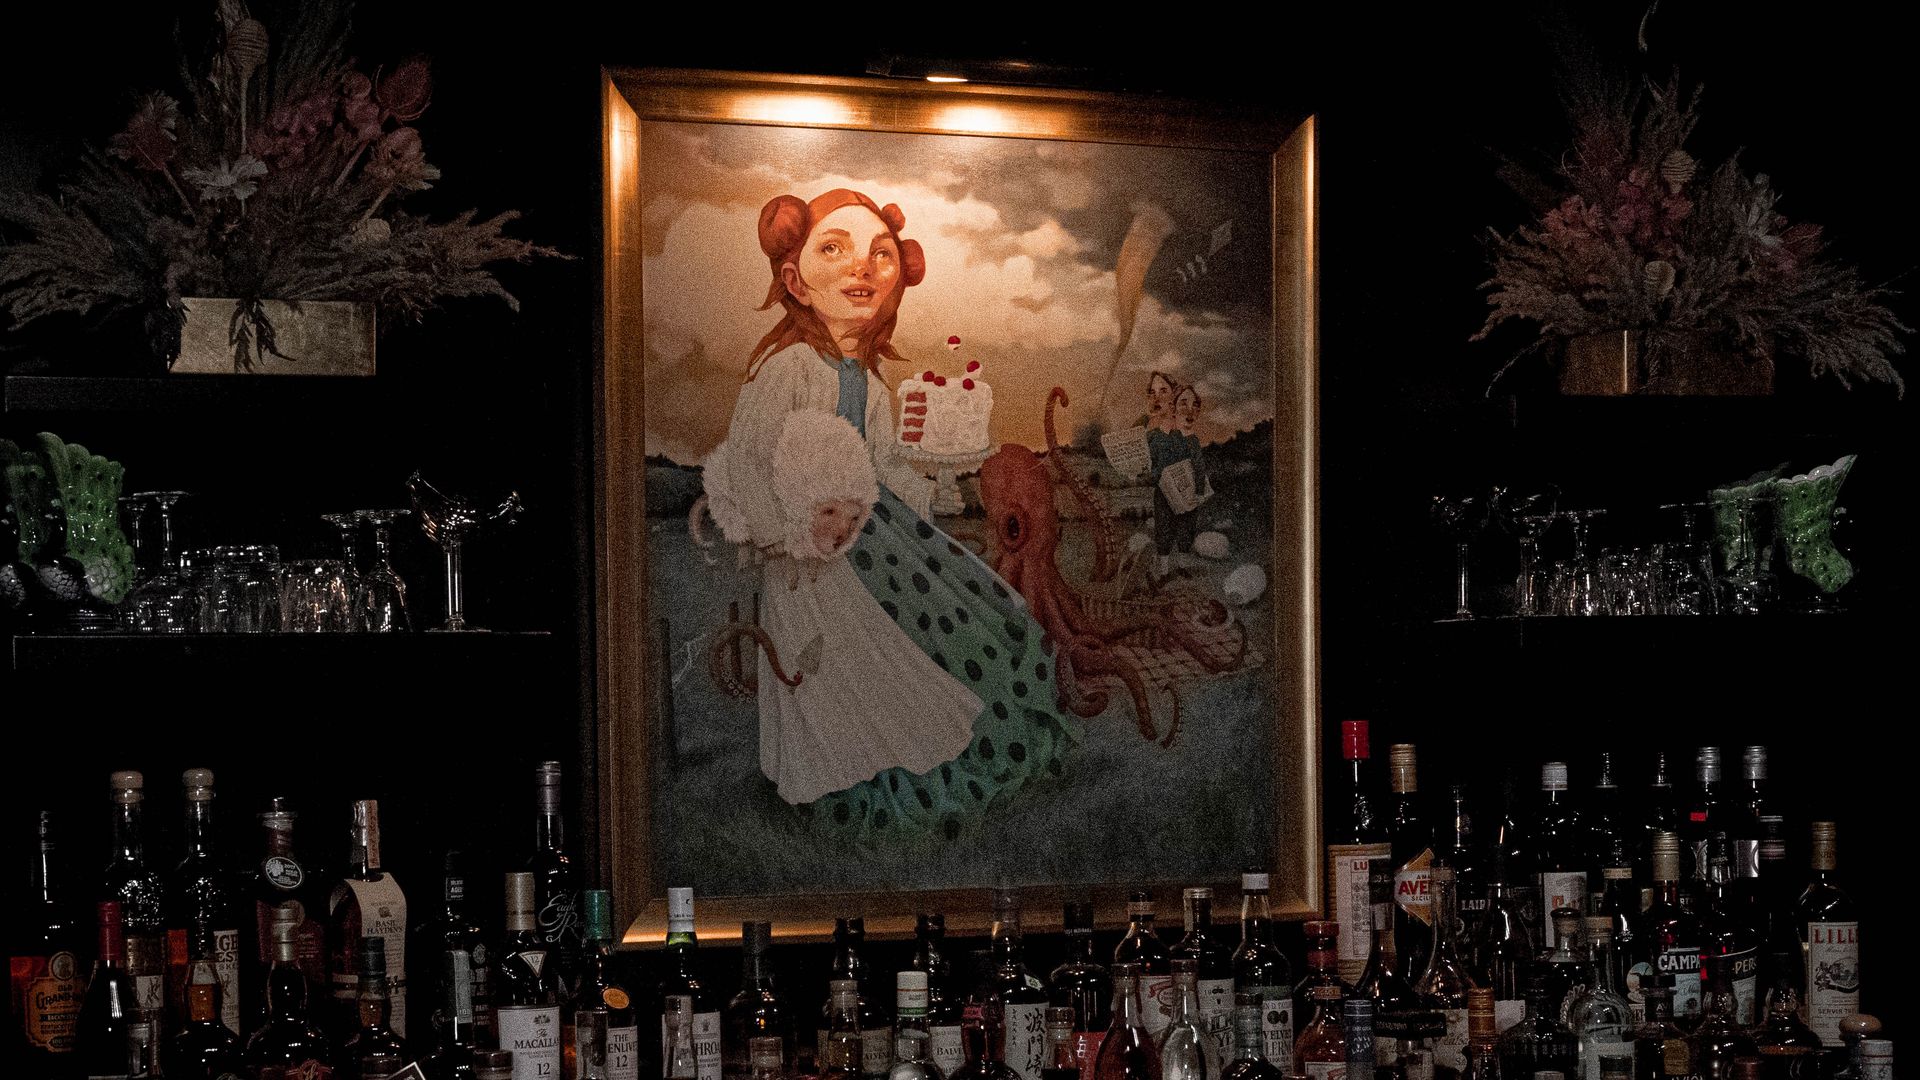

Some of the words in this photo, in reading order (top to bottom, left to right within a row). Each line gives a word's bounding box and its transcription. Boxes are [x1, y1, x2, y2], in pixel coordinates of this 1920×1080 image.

[375, 920, 396, 928] BASIL
[613, 1033, 629, 1043] THE
[615, 1054, 628, 1068] 12
[537, 1062, 551, 1076] 12
